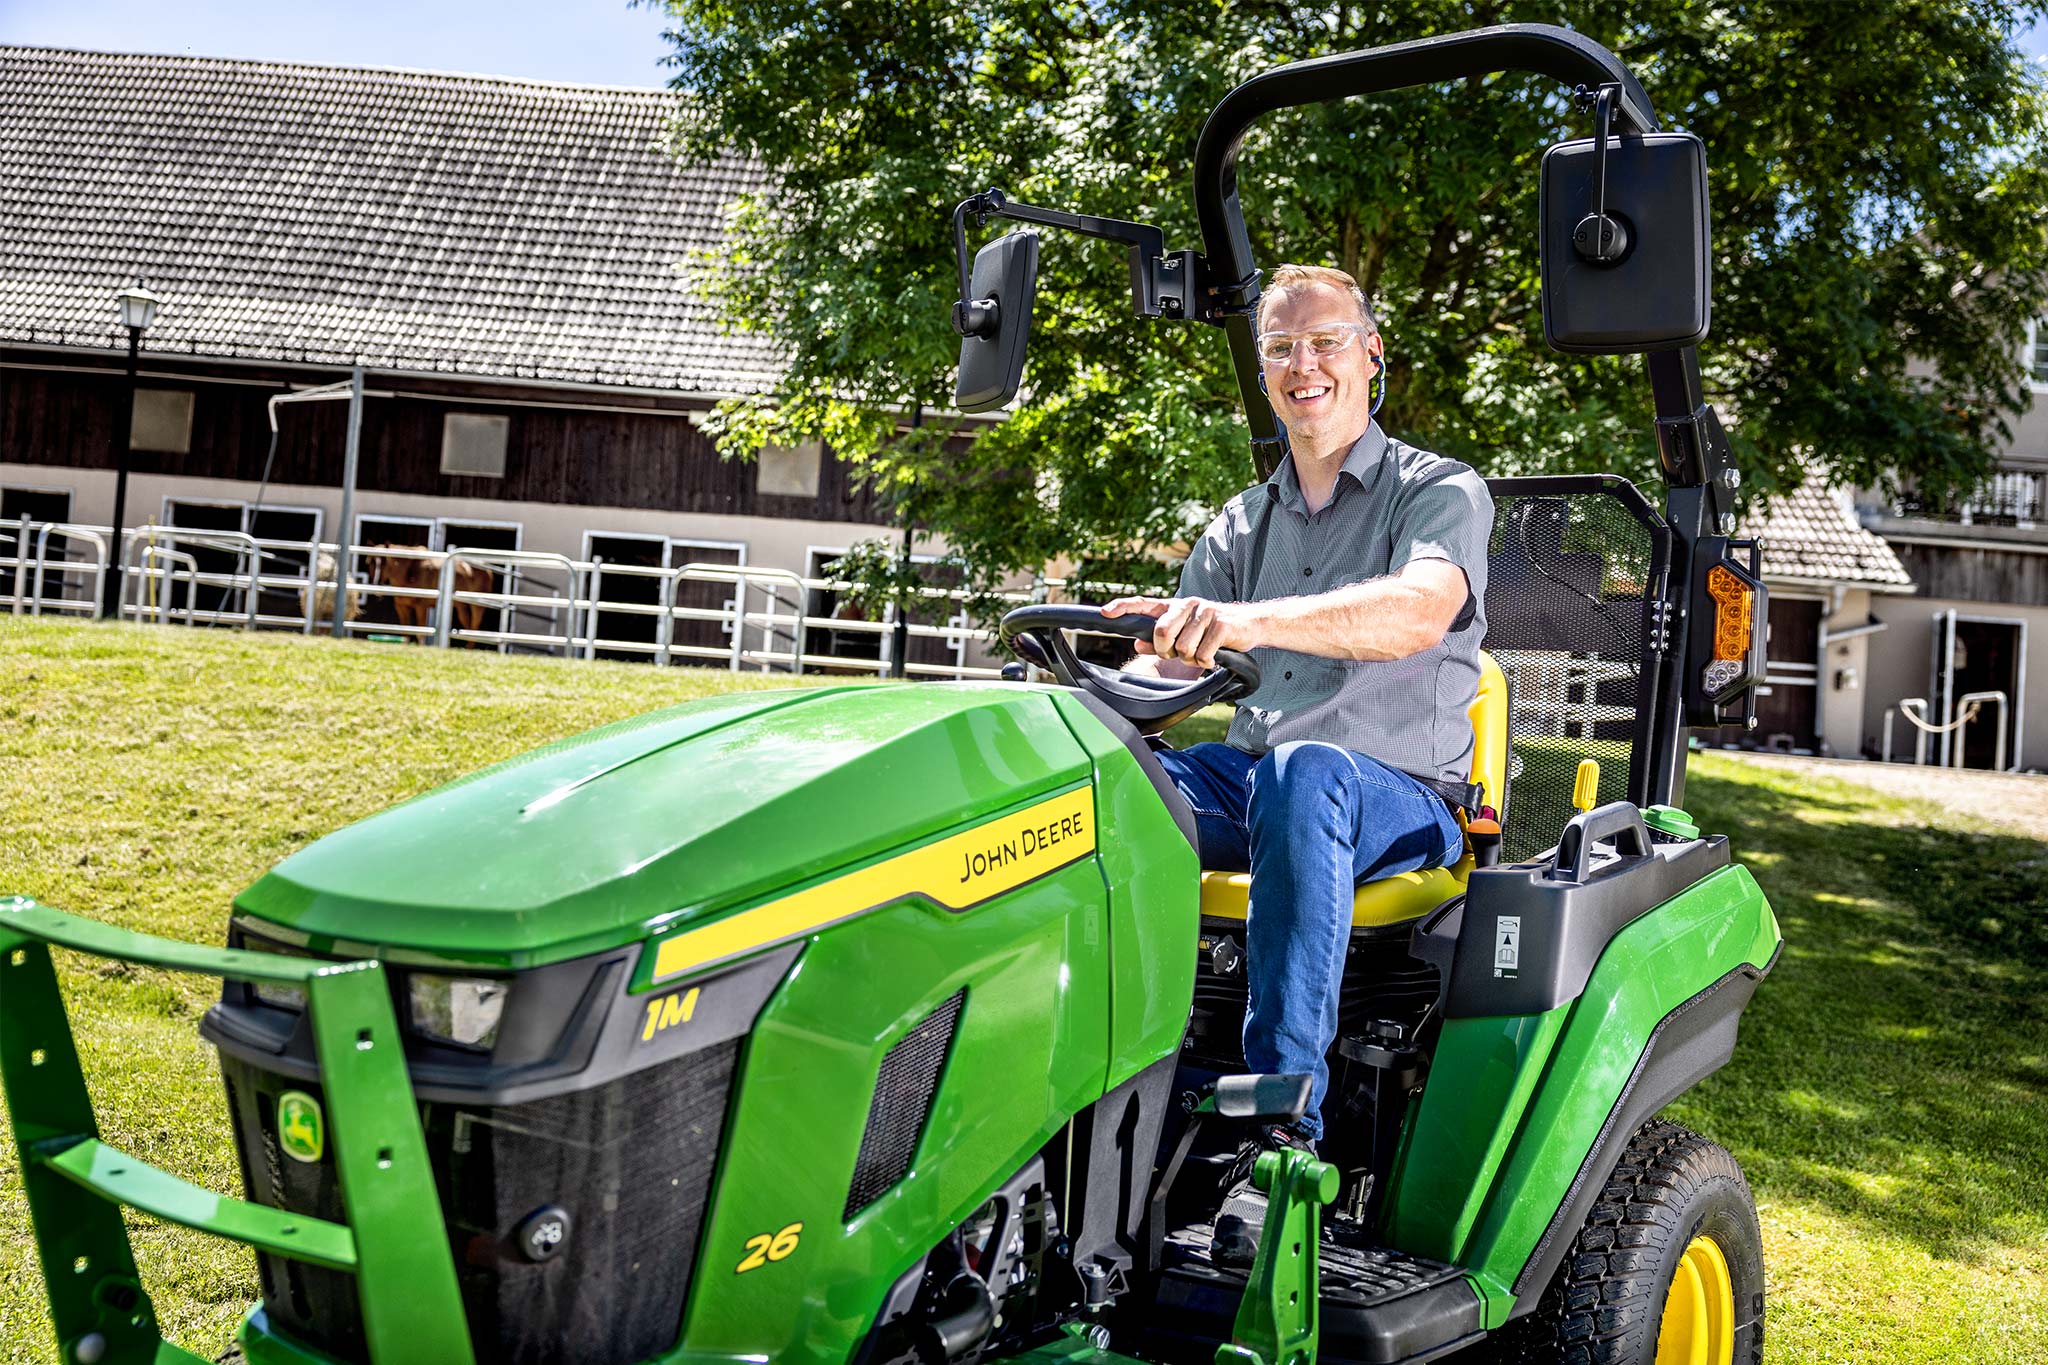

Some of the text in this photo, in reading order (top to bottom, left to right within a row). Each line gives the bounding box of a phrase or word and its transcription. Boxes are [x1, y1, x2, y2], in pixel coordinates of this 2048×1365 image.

[960, 812, 1083, 883] JOHN DEERE
[642, 986, 700, 1041] 1M
[735, 1221, 803, 1274] 26
